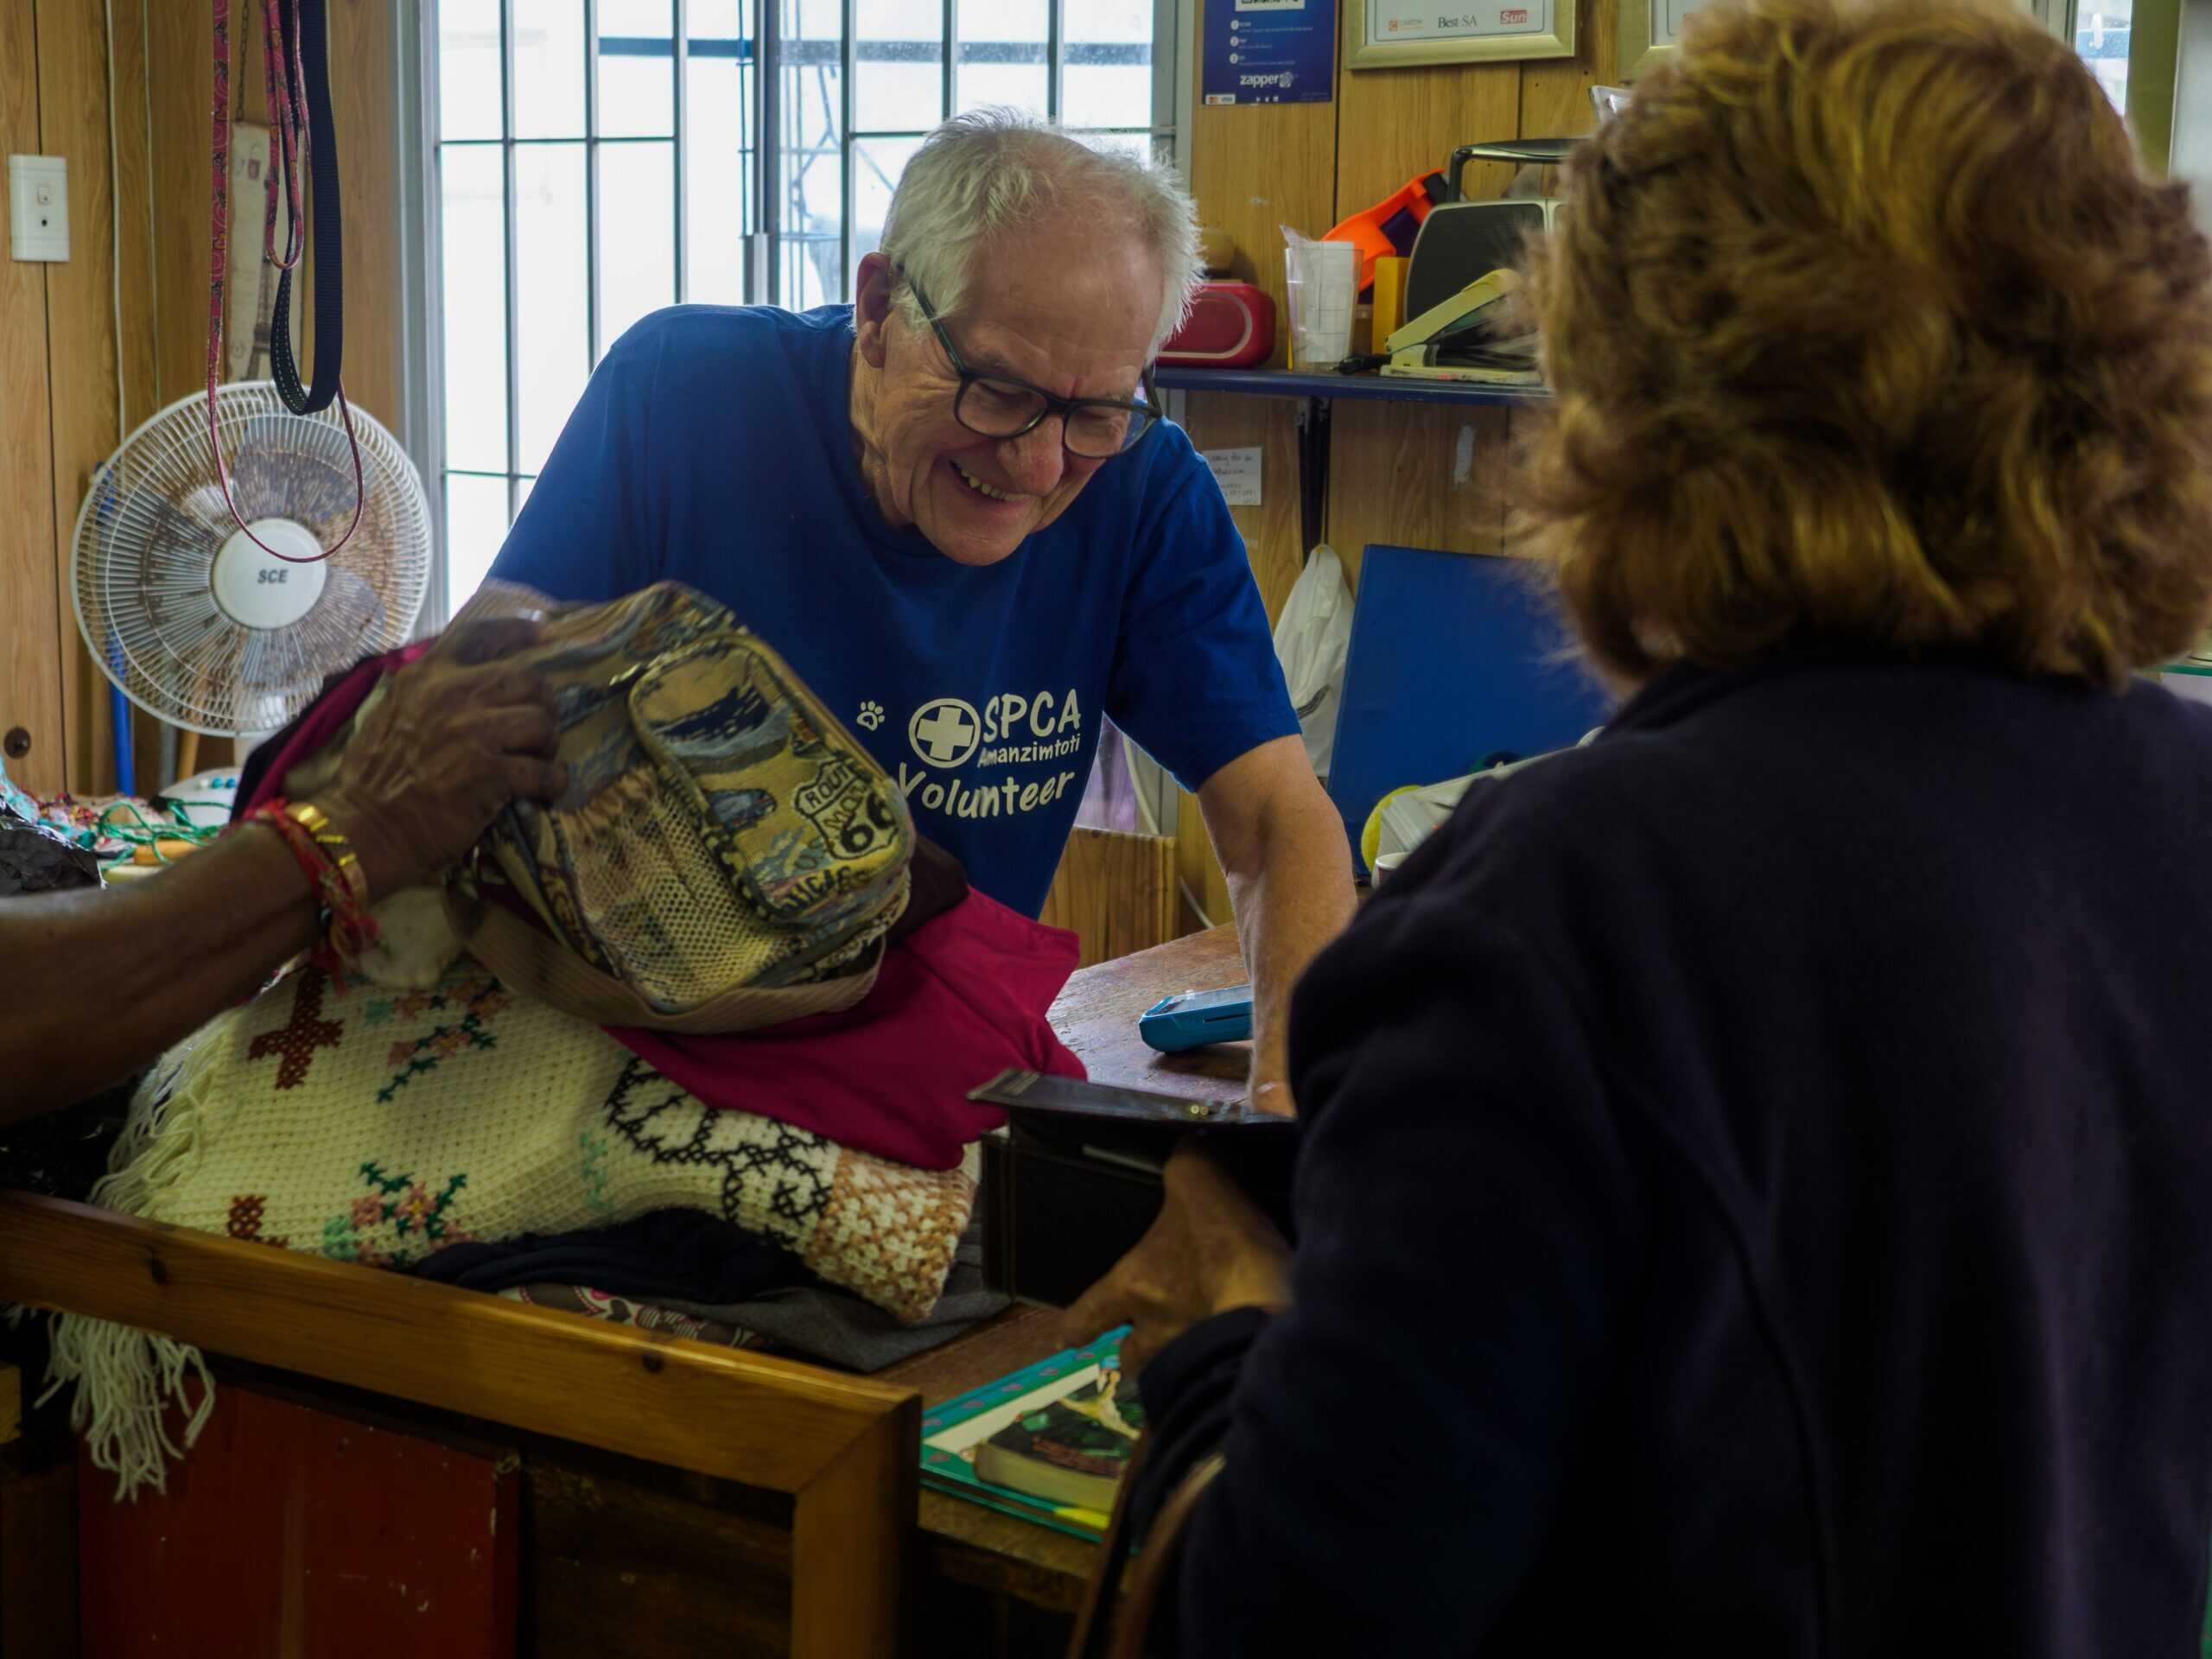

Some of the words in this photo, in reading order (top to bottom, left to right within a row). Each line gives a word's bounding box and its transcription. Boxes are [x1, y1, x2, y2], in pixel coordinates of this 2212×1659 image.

[1438, 16, 1459, 29] Best
[1461, 14, 1478, 27] SA
[1500, 10, 1527, 24] Sun
[1239, 74, 1280, 88] zapper
[257, 569, 287, 583] SCE
[982, 688, 1082, 743] SPCA
[977, 734, 1081, 768] Amanzimtoti
[899, 762, 1076, 819] Volunteer
